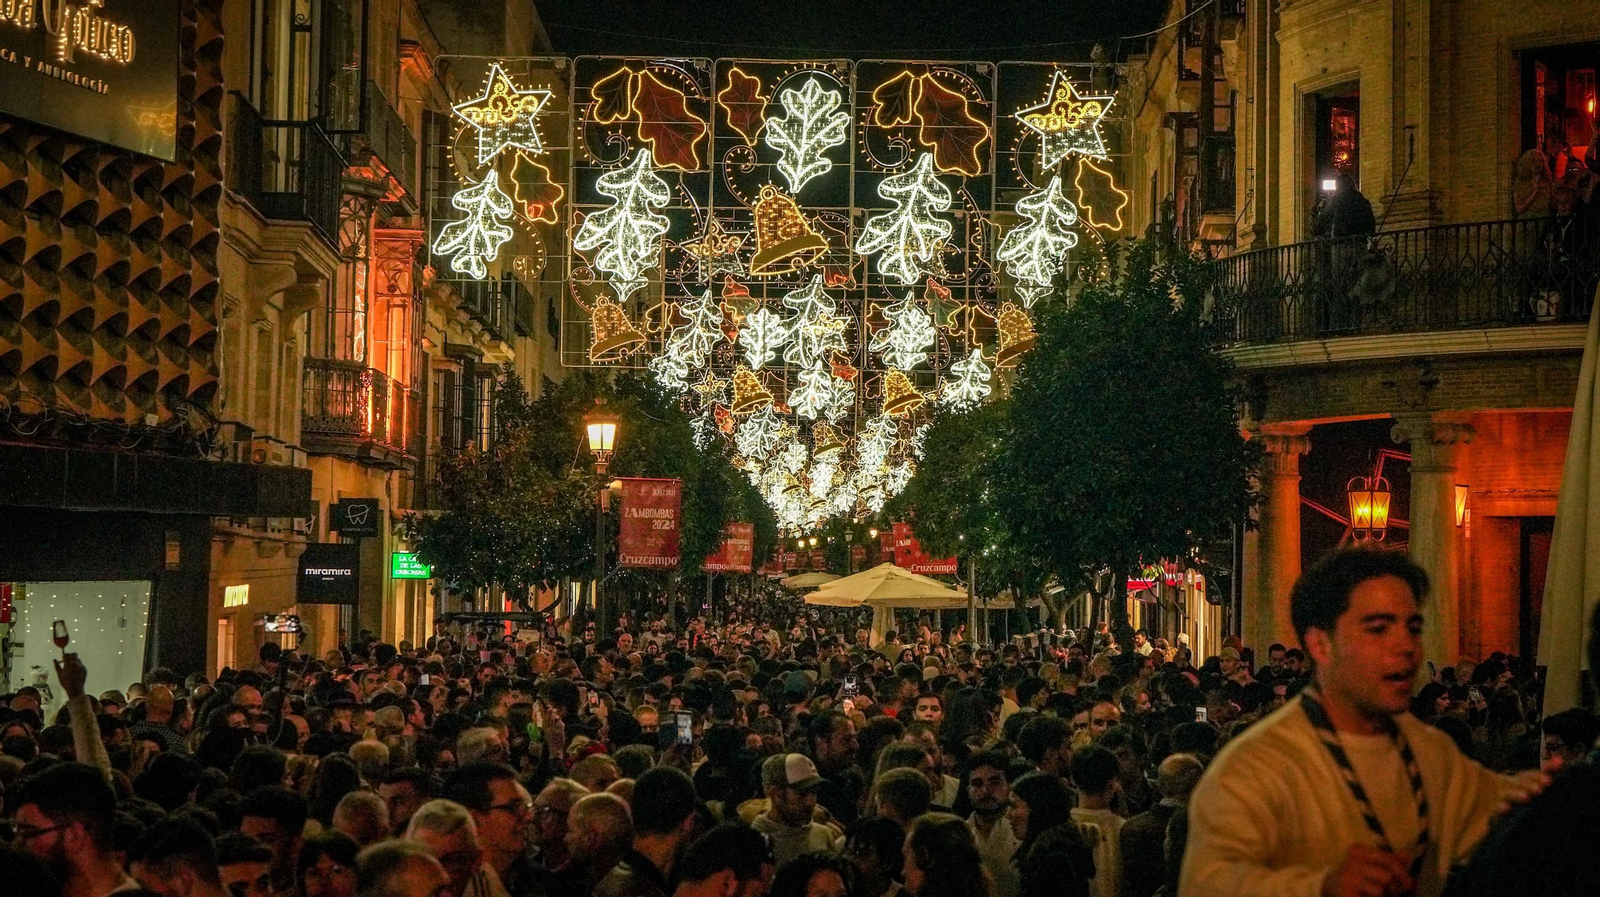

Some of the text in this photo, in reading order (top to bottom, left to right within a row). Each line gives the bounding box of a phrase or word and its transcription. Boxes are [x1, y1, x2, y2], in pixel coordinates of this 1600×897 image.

[24, 56, 31, 68] Y
[37, 61, 109, 95] AUDIOLOGÍA
[625, 507, 674, 519] ZAMBOMBAS
[652, 519, 675, 530] 2024
[620, 553, 677, 566] Cruzcampo
[305, 568, 351, 576] miramira
[911, 563, 957, 573] Cruzcampo
